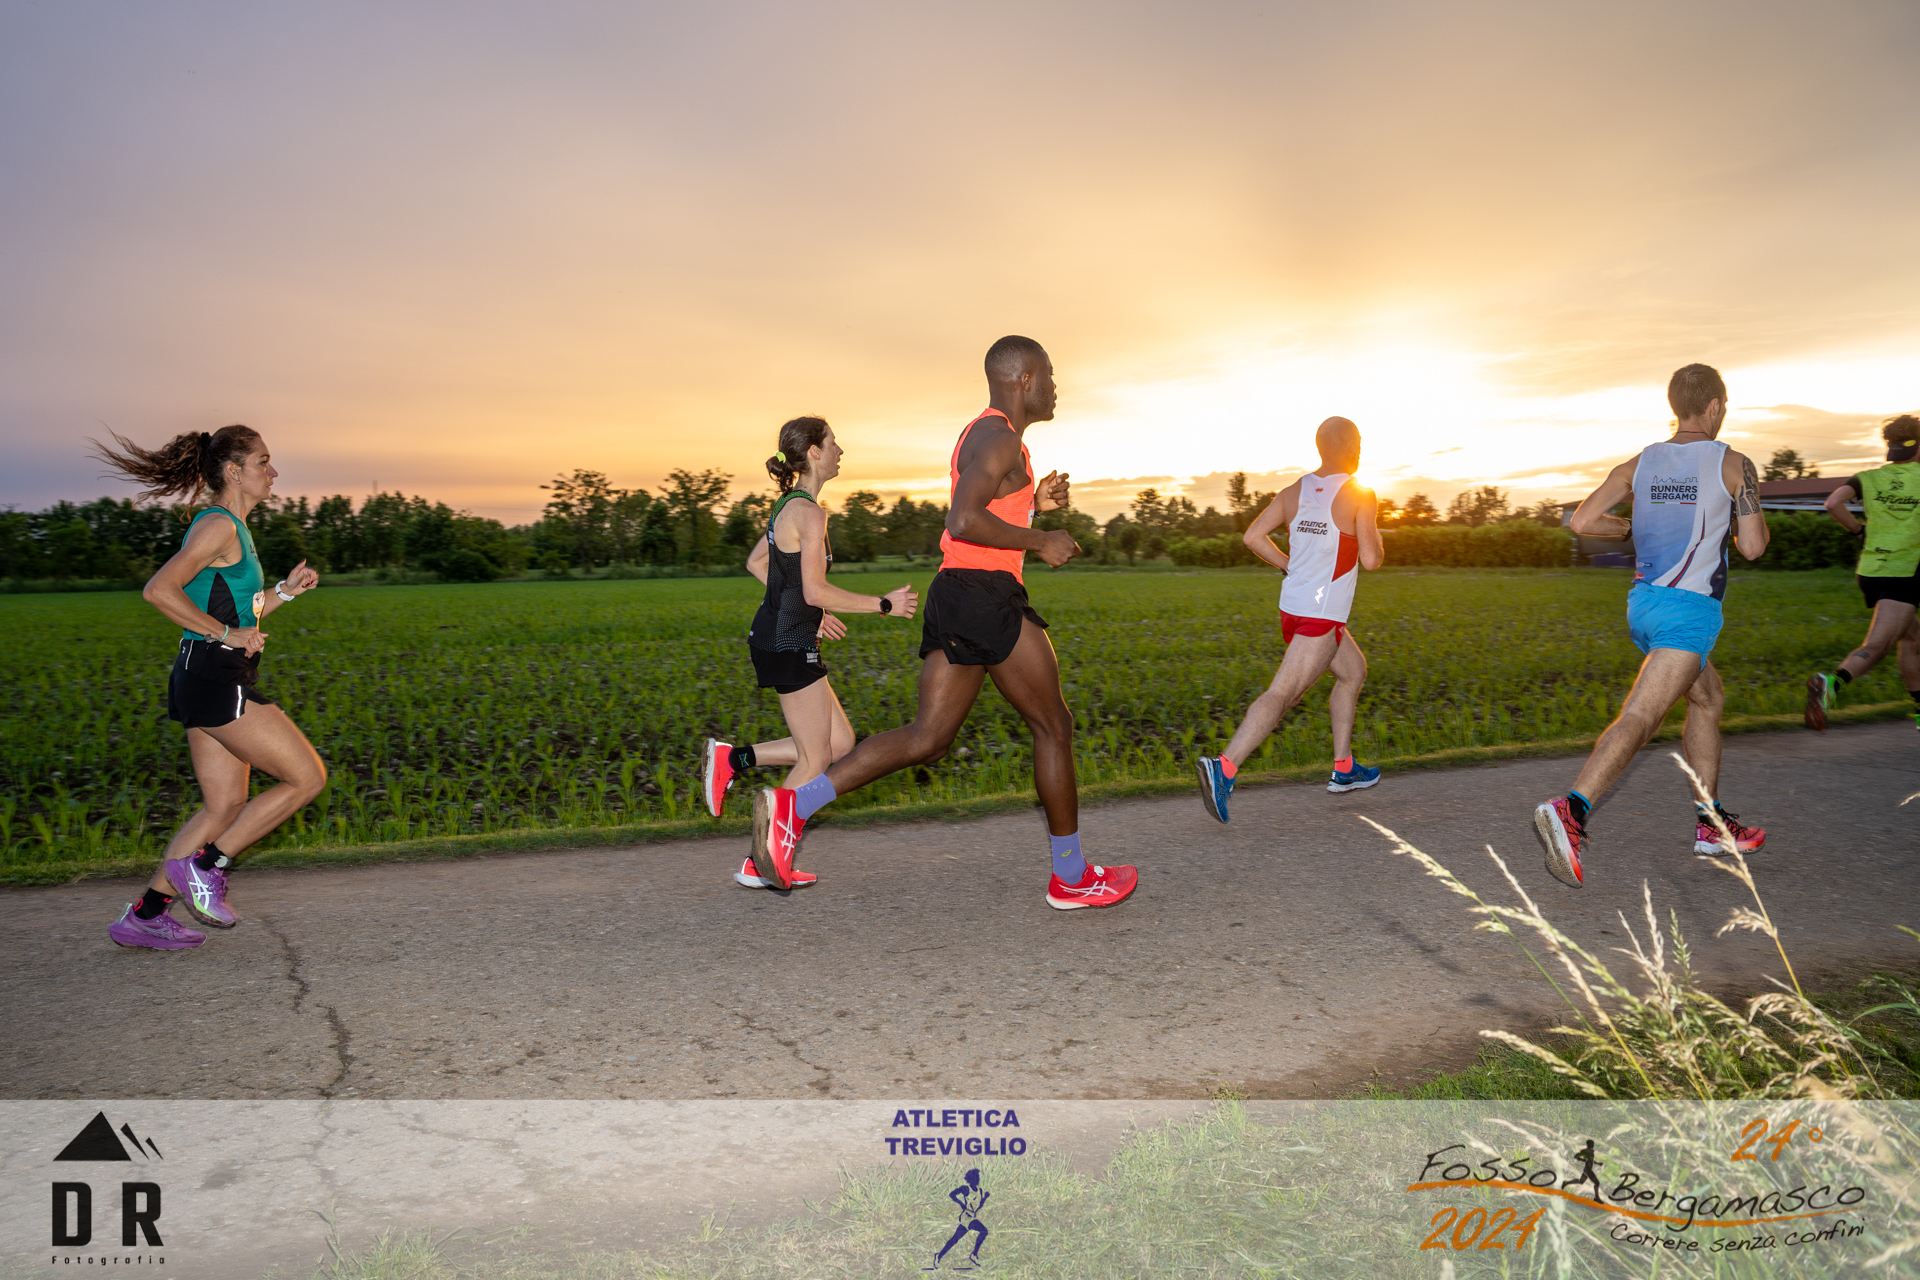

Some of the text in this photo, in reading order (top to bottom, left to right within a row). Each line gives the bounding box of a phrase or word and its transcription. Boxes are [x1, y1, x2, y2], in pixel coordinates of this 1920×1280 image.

[1651, 485, 1698, 493] RUNNERS
[1651, 493, 1697, 501] BERGAMO
[1299, 520, 1327, 528] ATLETICA
[1296, 526, 1328, 536] TREVIGLIO
